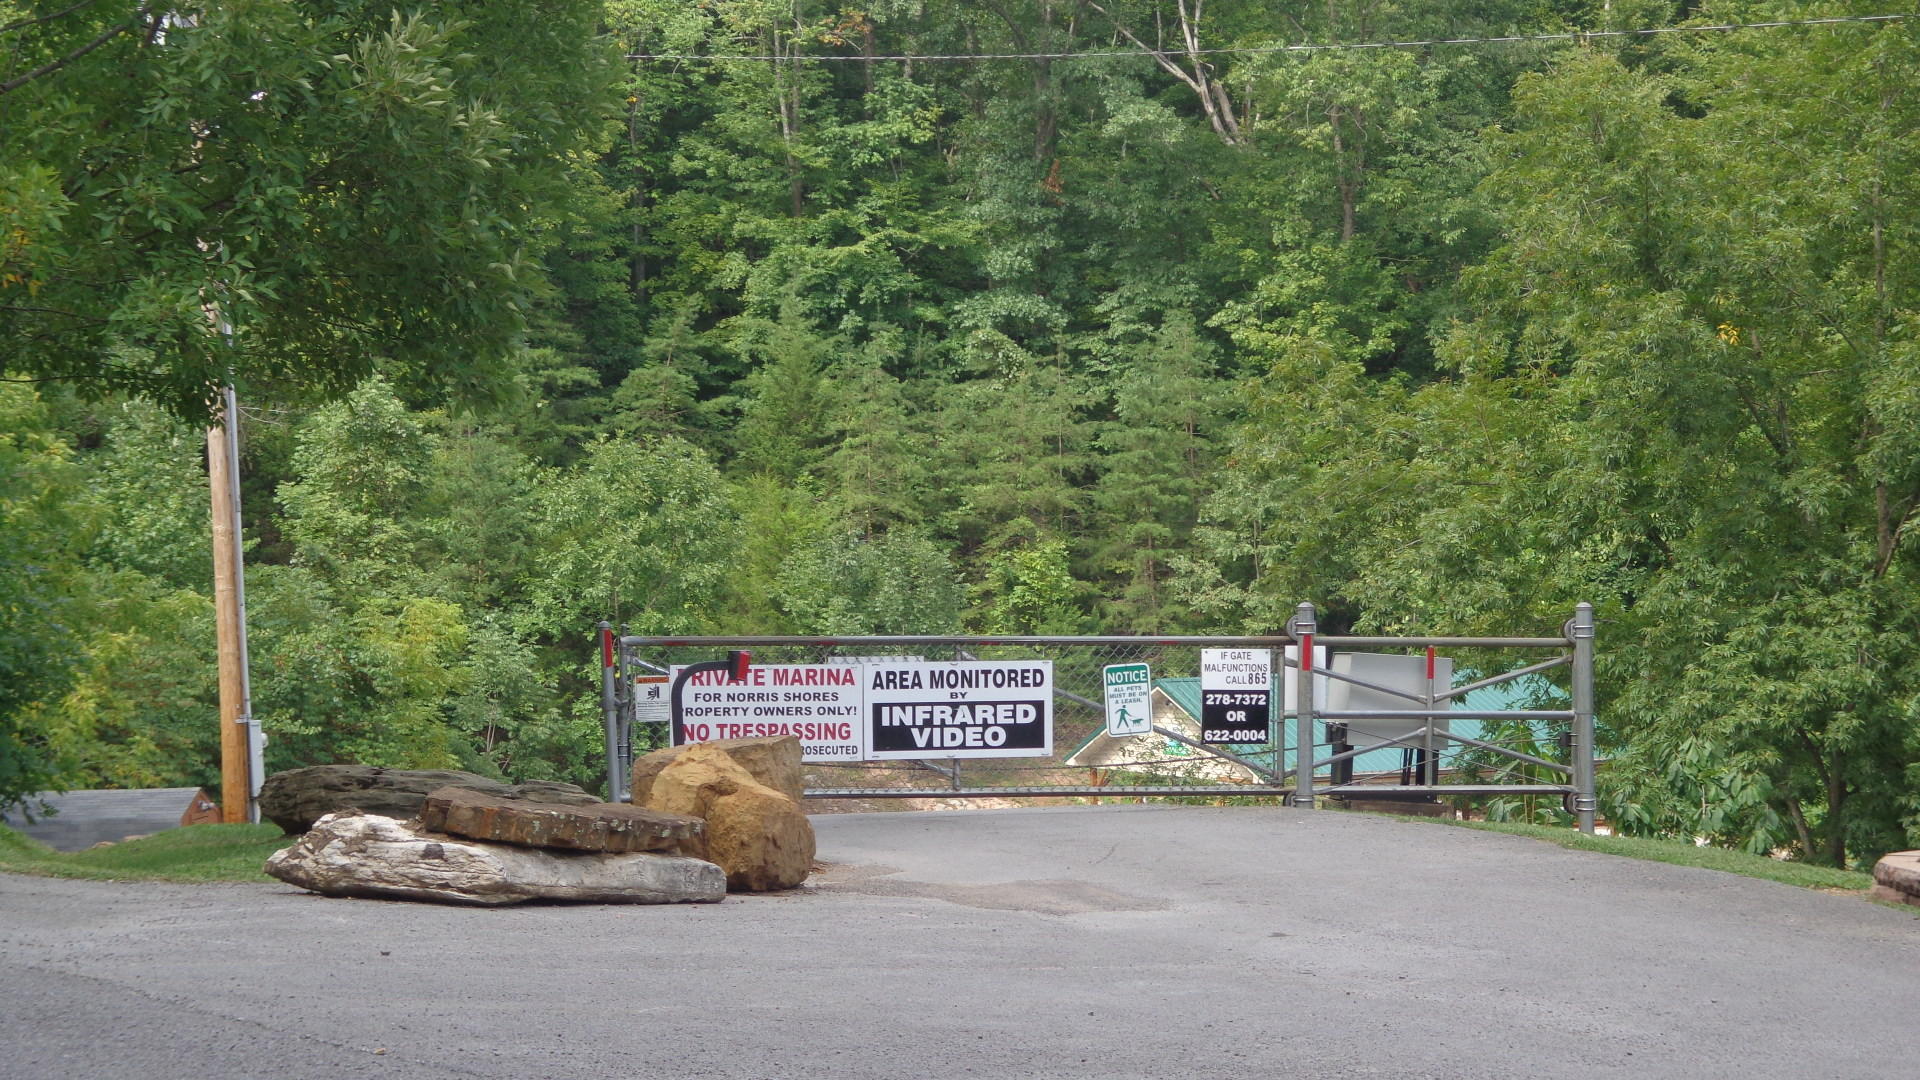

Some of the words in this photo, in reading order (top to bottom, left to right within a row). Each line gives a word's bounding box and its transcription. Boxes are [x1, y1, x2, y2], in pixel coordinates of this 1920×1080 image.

[1220, 652, 1228, 660] IF
[1230, 652, 1252, 660] GATE
[1204, 664, 1268, 672] MALFUNCTIONS
[773, 668, 856, 686] MARINA
[872, 670, 924, 690] AREA
[930, 668, 1044, 690] MONITORED
[1108, 670, 1148, 684] NOTICE
[1226, 676, 1246, 684] CALL
[1248, 673, 1267, 685] 865
[694, 692, 722, 703] FOR
[726, 692, 778, 702] NORRIS
[784, 692, 839, 702] SHORES
[1206, 694, 1266, 705] 278-7372
[682, 706, 749, 717] ROPERTY
[754, 706, 812, 716] OWNERS
[817, 705, 857, 716] ONLY!
[882, 704, 1036, 726] INFRARED
[1226, 710, 1246, 722] OR
[683, 724, 710, 741] NO
[716, 722, 852, 740] TRESPASSING
[911, 726, 1006, 748] VIDEO
[1204, 730, 1266, 741] 622-0004
